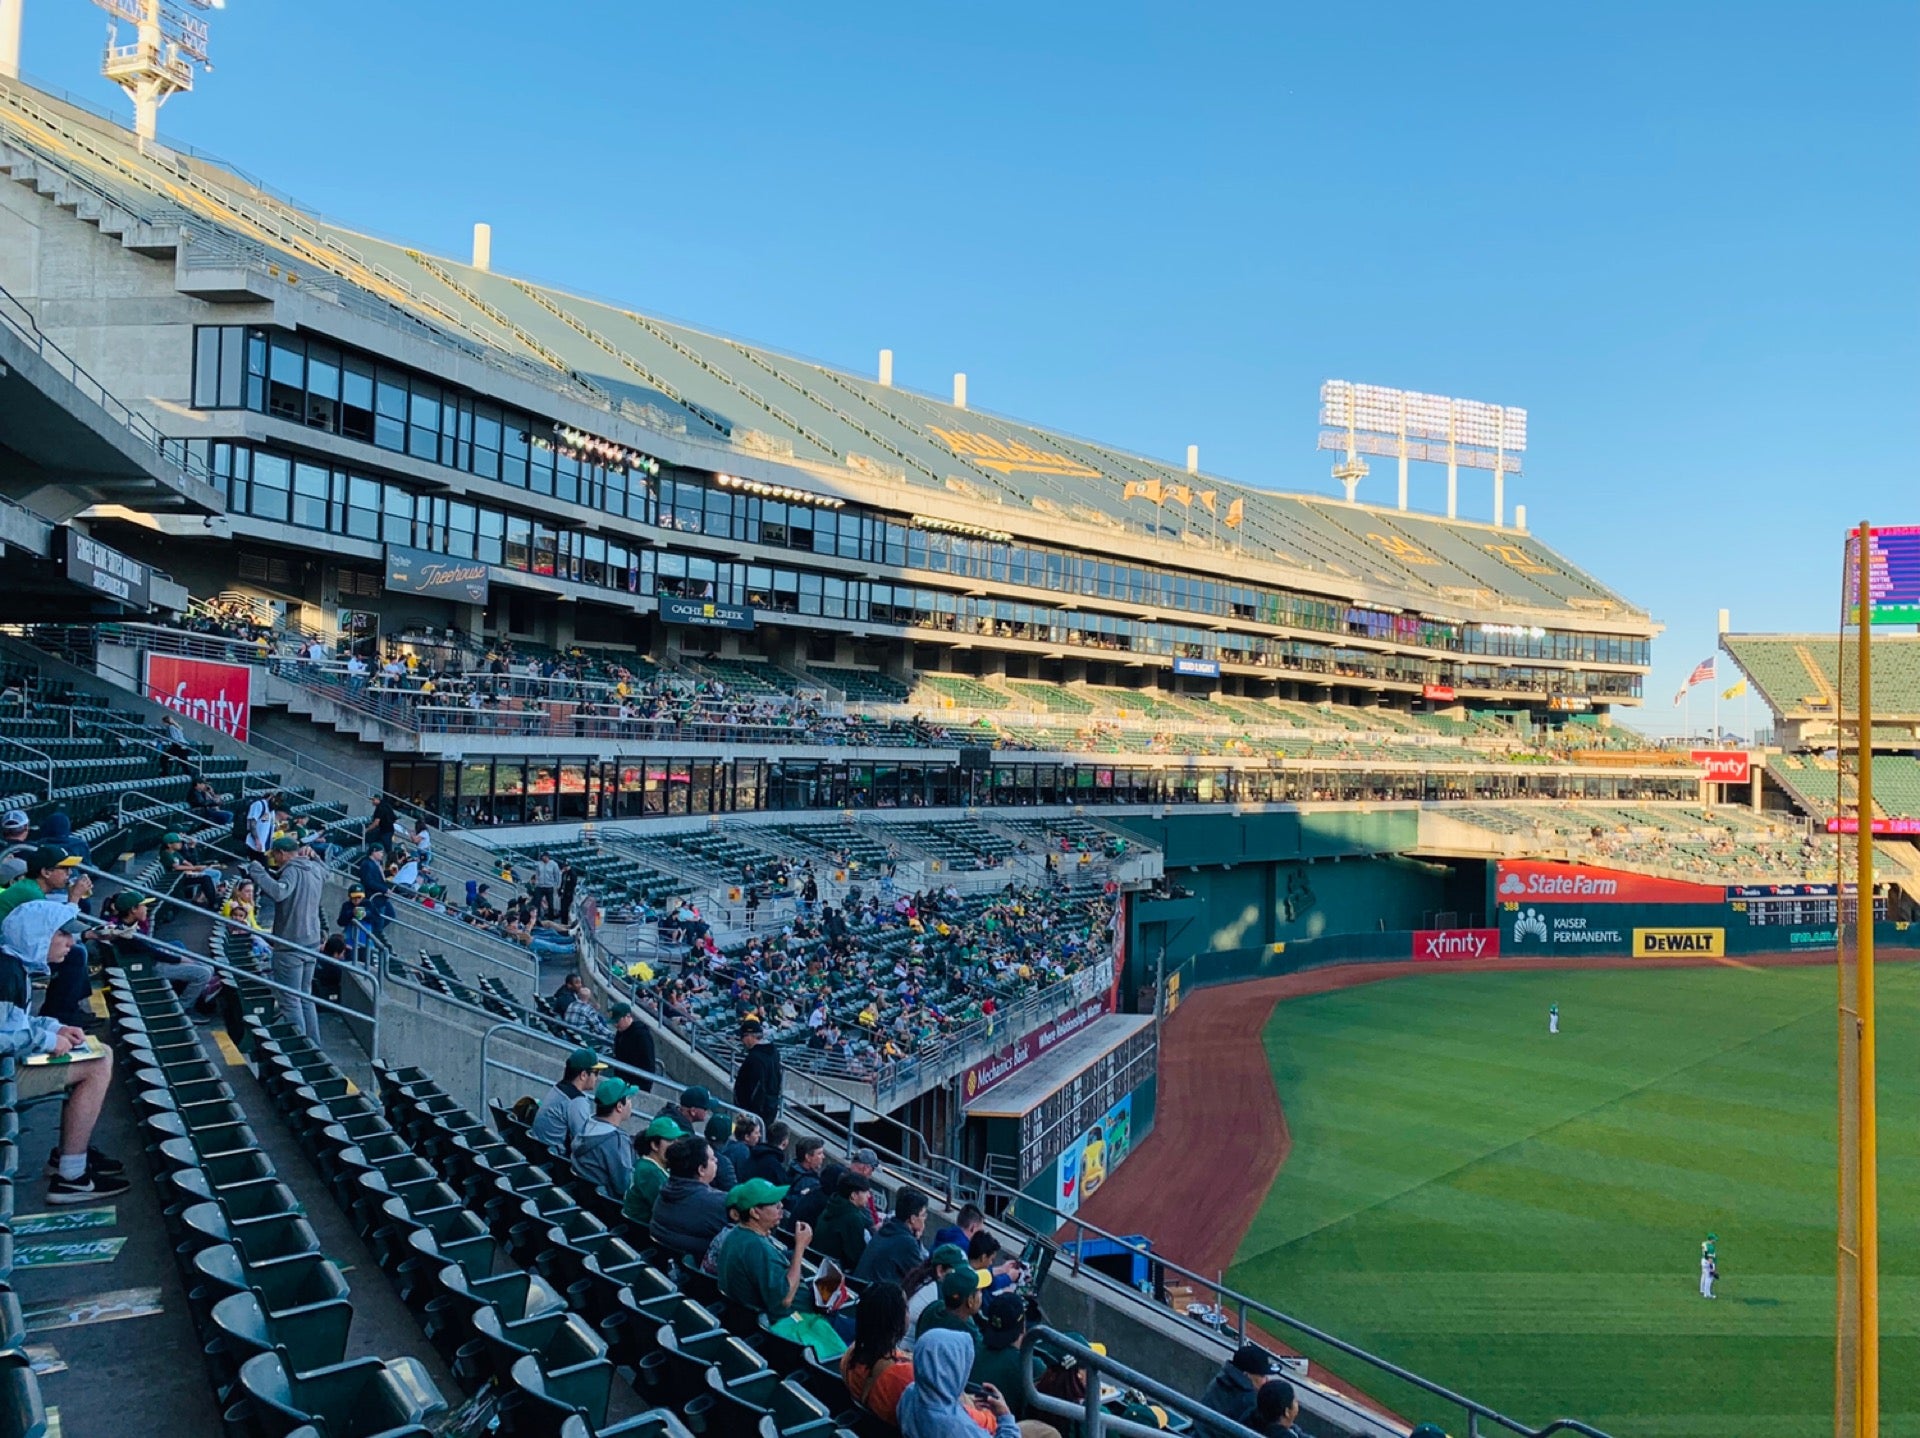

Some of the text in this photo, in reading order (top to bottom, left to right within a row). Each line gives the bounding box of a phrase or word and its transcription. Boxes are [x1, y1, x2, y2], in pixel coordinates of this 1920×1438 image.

[415, 563, 486, 591] Treehouse
[671, 604, 743, 620] CACHE CREEK
[1554, 918, 1587, 929] KAISER
[1426, 932, 1487, 959] xfinity
[1553, 931, 1619, 943] PERMANENTE
[976, 1056, 1013, 1089] Mechanics
[1013, 1042, 1029, 1066] Bank
